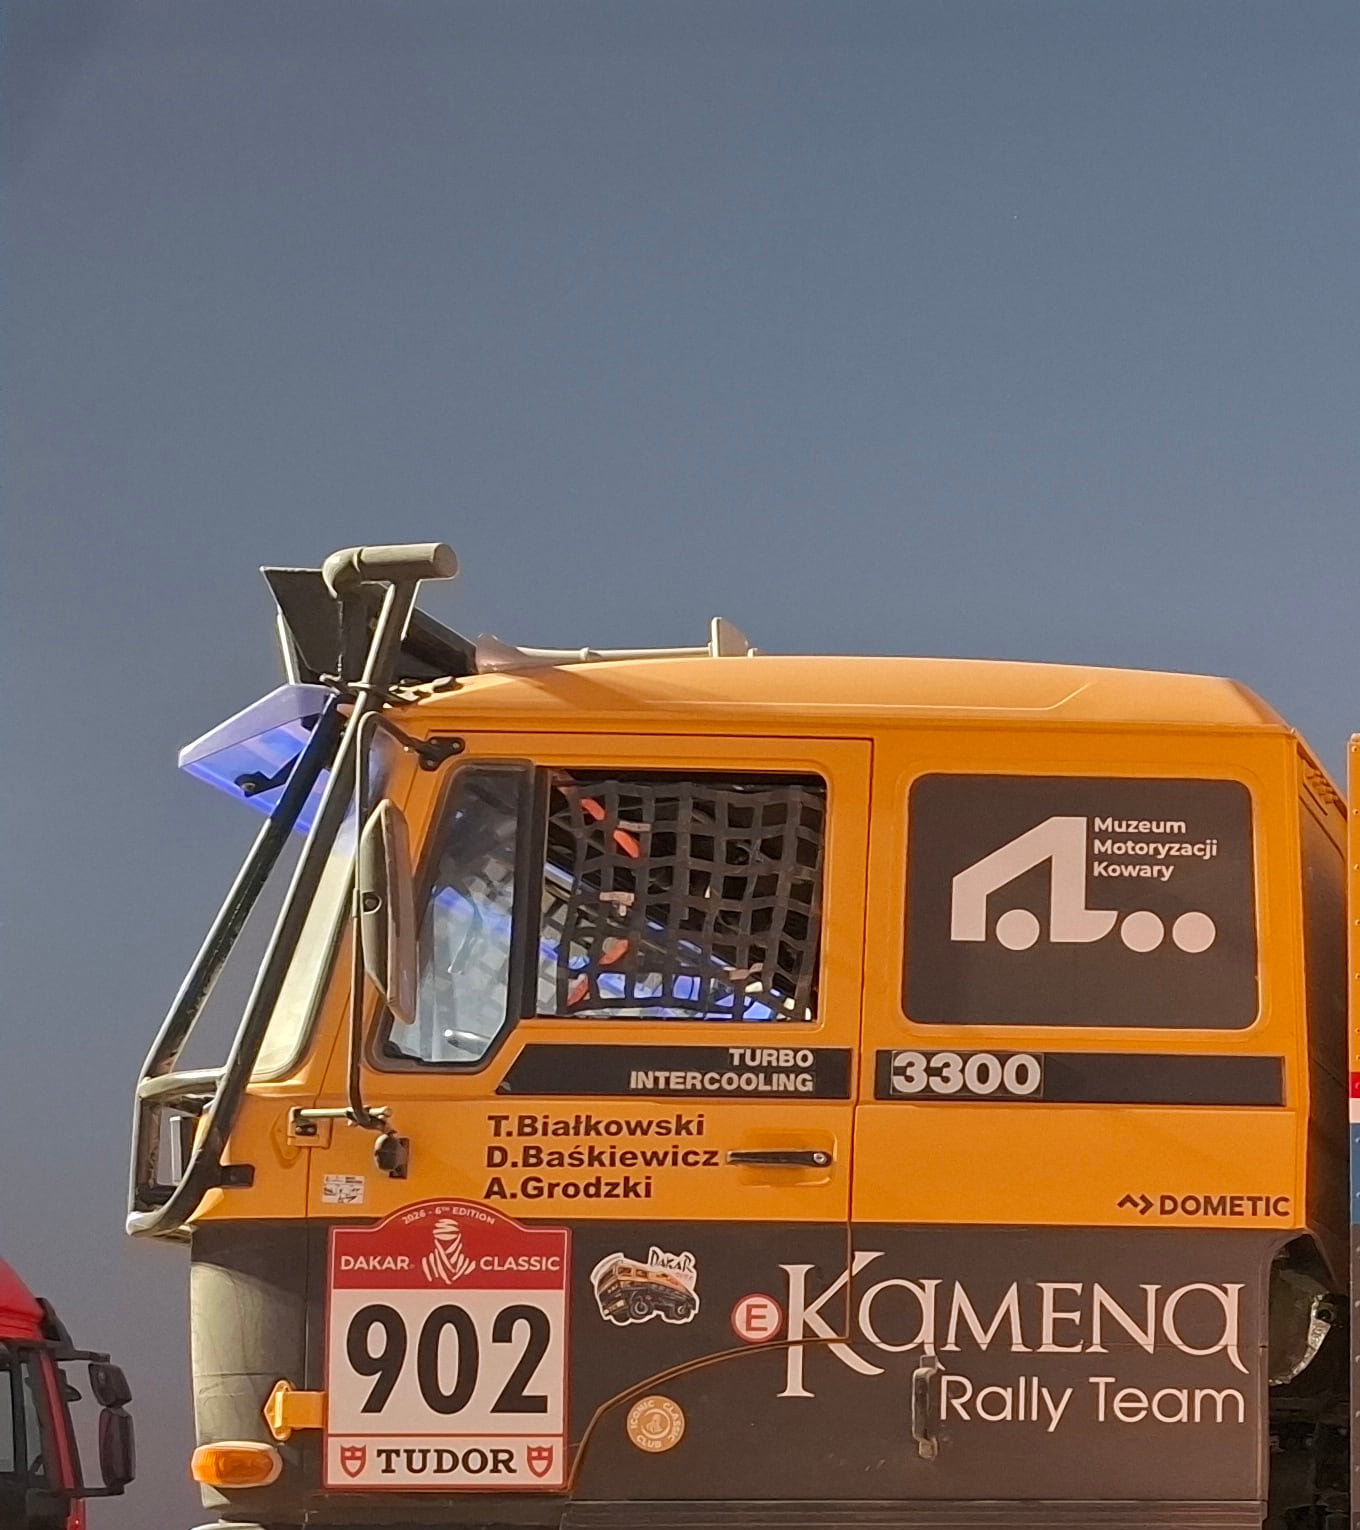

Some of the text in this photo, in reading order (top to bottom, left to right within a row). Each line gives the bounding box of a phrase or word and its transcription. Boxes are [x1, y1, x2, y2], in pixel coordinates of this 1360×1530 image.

[1093, 815, 1186, 834] Muzeum
[1093, 837, 1218, 858] Motoryzacji
[1093, 860, 1174, 881] Kowary
[728, 1048, 814, 1069] TURBO
[629, 1070, 814, 1092] INTERCOOLING
[891, 1052, 1042, 1095] 3300
[487, 1114, 706, 1139] T.Białkowski
[485, 1142, 720, 1170] D.Baśkiewicz
[483, 1176, 653, 1201] A.Grodzki
[403, 1207, 427, 1224] 2026
[453, 1207, 495, 1224] EDITION
[1159, 1195, 1291, 1217] DOMETIC
[341, 1256, 560, 1270] DAKAR CLASSIC
[650, 1249, 694, 1274] DAKAR
[745, 1303, 768, 1333] E
[346, 1304, 550, 1416] 902
[940, 1375, 1245, 1432] Rally Team
[376, 1449, 517, 1474] TUDOR
